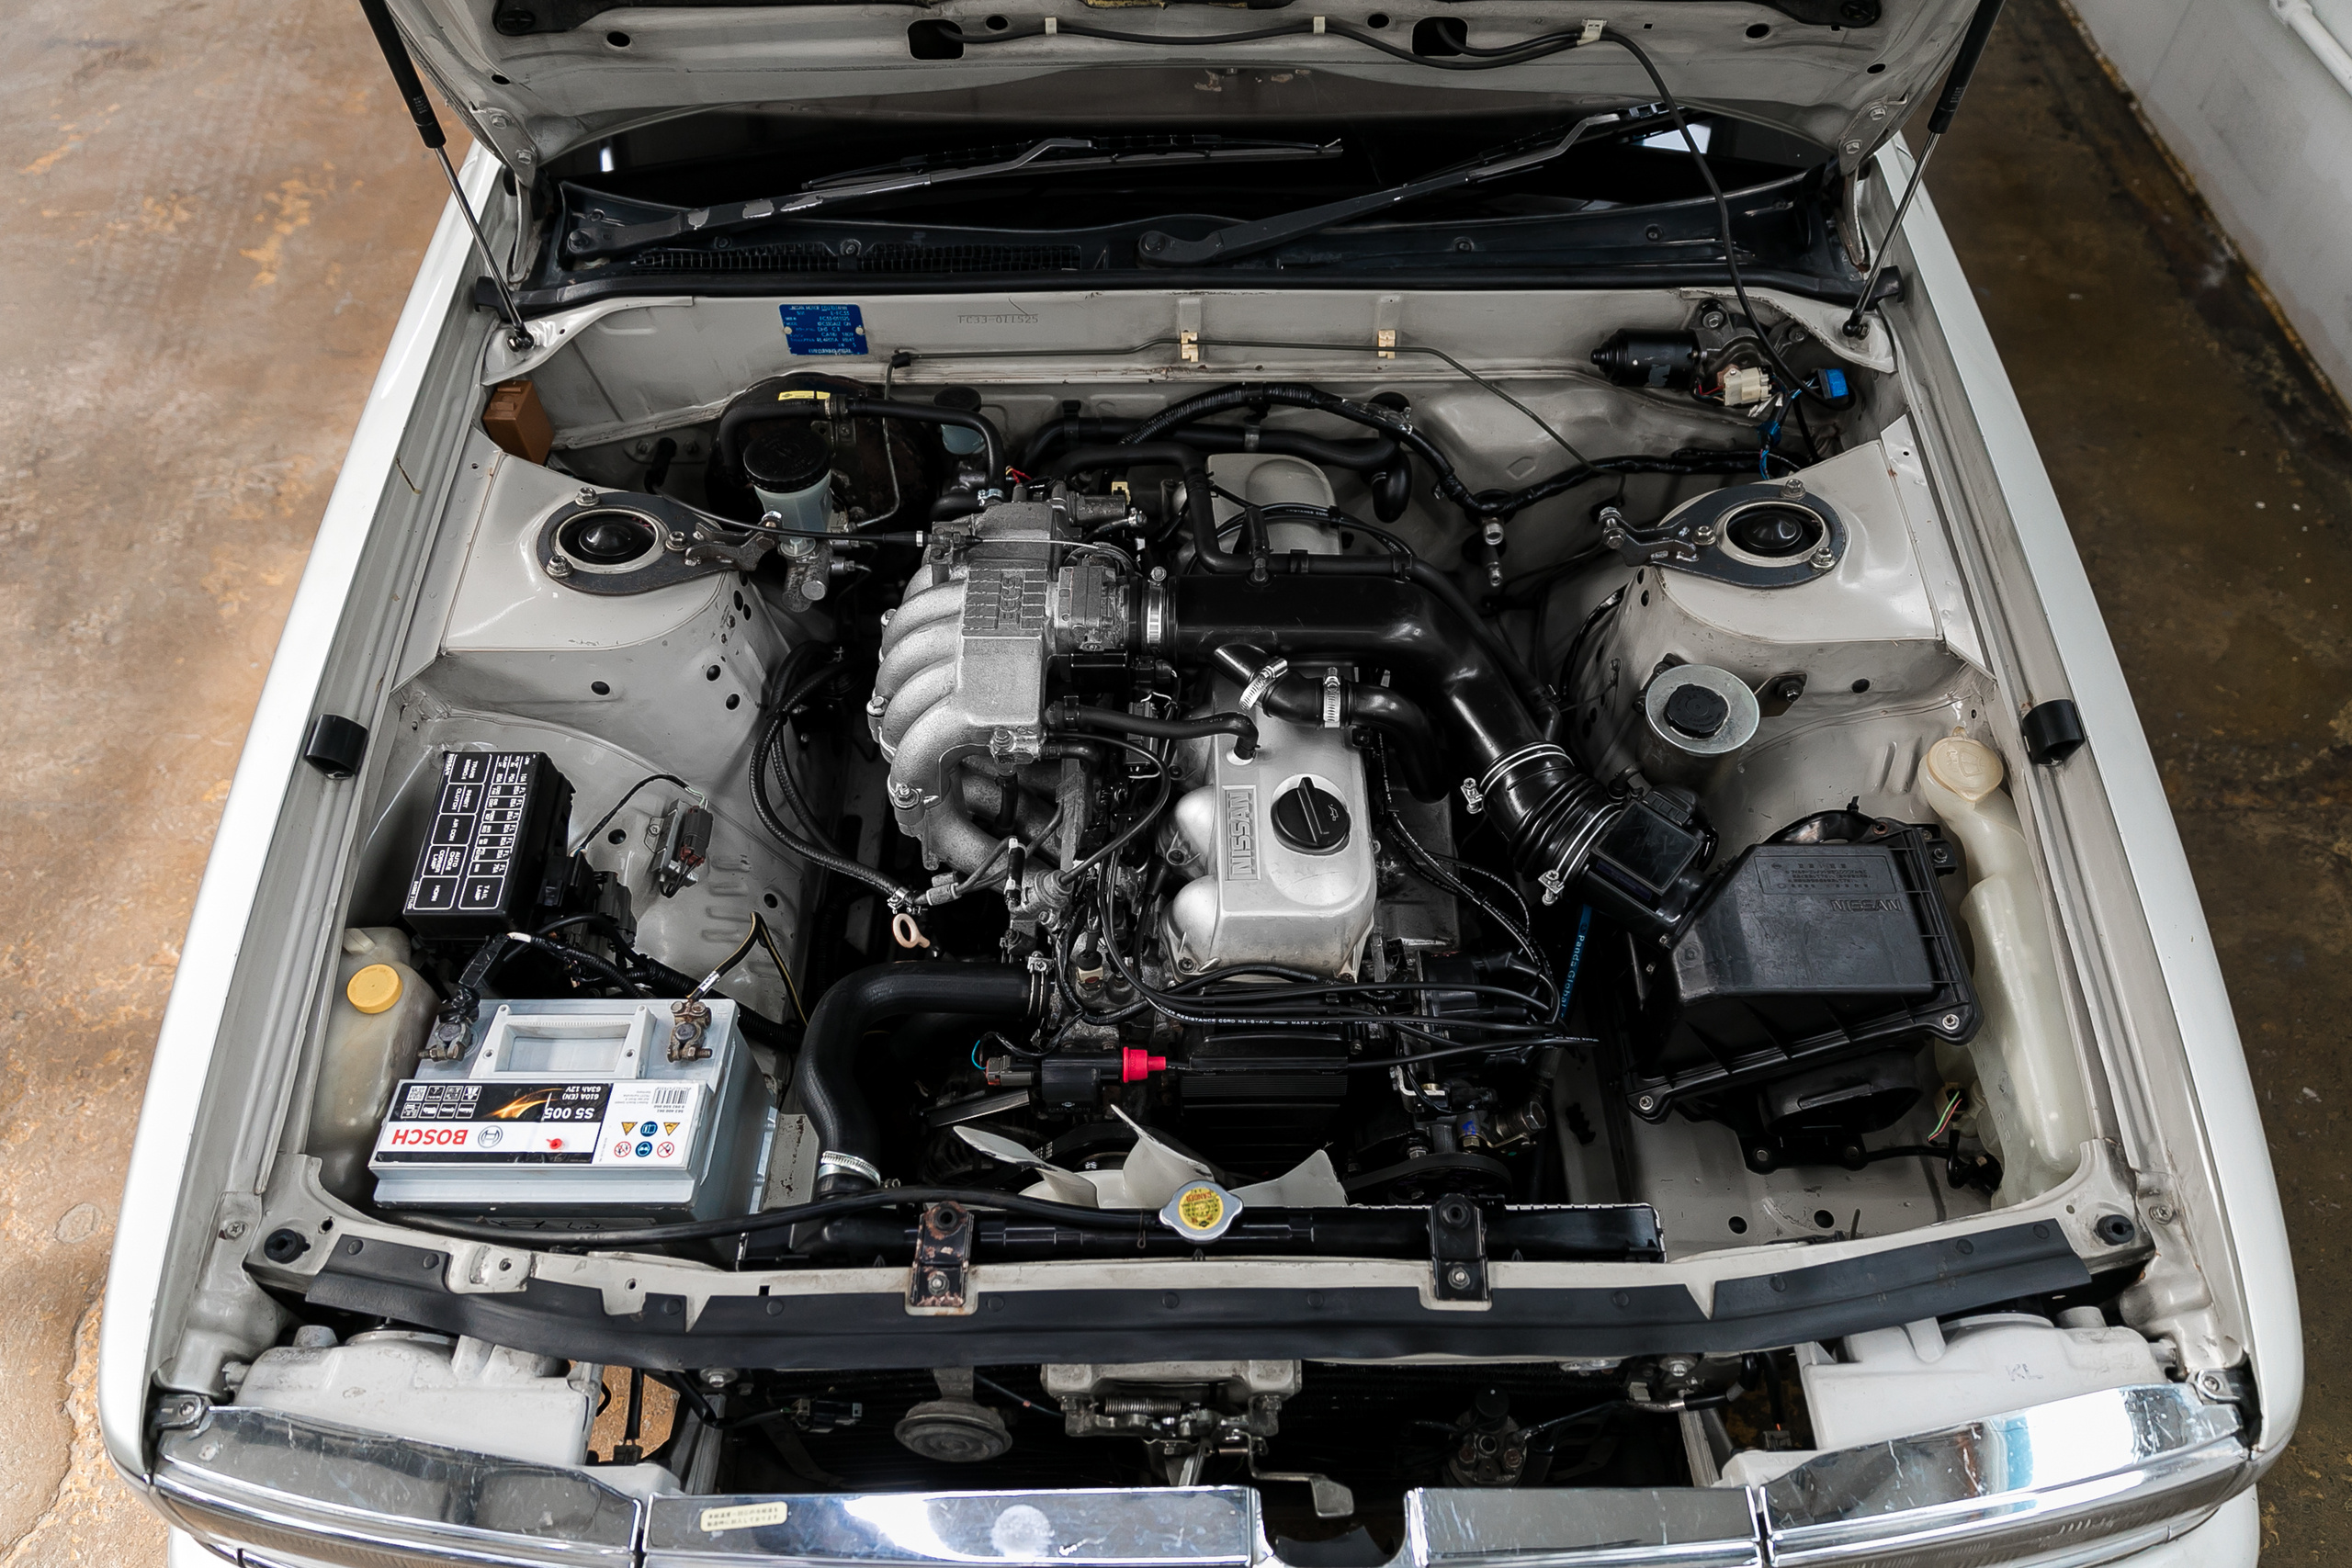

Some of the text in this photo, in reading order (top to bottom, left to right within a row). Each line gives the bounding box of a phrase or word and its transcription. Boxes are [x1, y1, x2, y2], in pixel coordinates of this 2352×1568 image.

[958, 315, 1038, 323] FC33-011525
[469, 761, 478, 779] TRANS
[452, 788, 463, 810] CLUTCH
[448, 818, 459, 841] AIR CON
[1227, 790, 1253, 874] NISSAN
[430, 853, 439, 870] LAMP
[435, 850, 445, 873] CORNER
[446, 852, 455, 871] CHOKE
[452, 852, 461, 867] AUTO
[431, 885, 441, 901] HORN
[474, 885, 482, 901] LAMP
[481, 885, 490, 899] TAIL
[1830, 899, 1903, 912] NISSAN
[1560, 934, 1586, 1010] Panda Global
[1177, 1013, 1216, 1023] RESISTANCE
[544, 1108, 595, 1119] S5 005
[390, 1129, 469, 1145] BOSCH
[1186, 1191, 1212, 1201] DANGER
